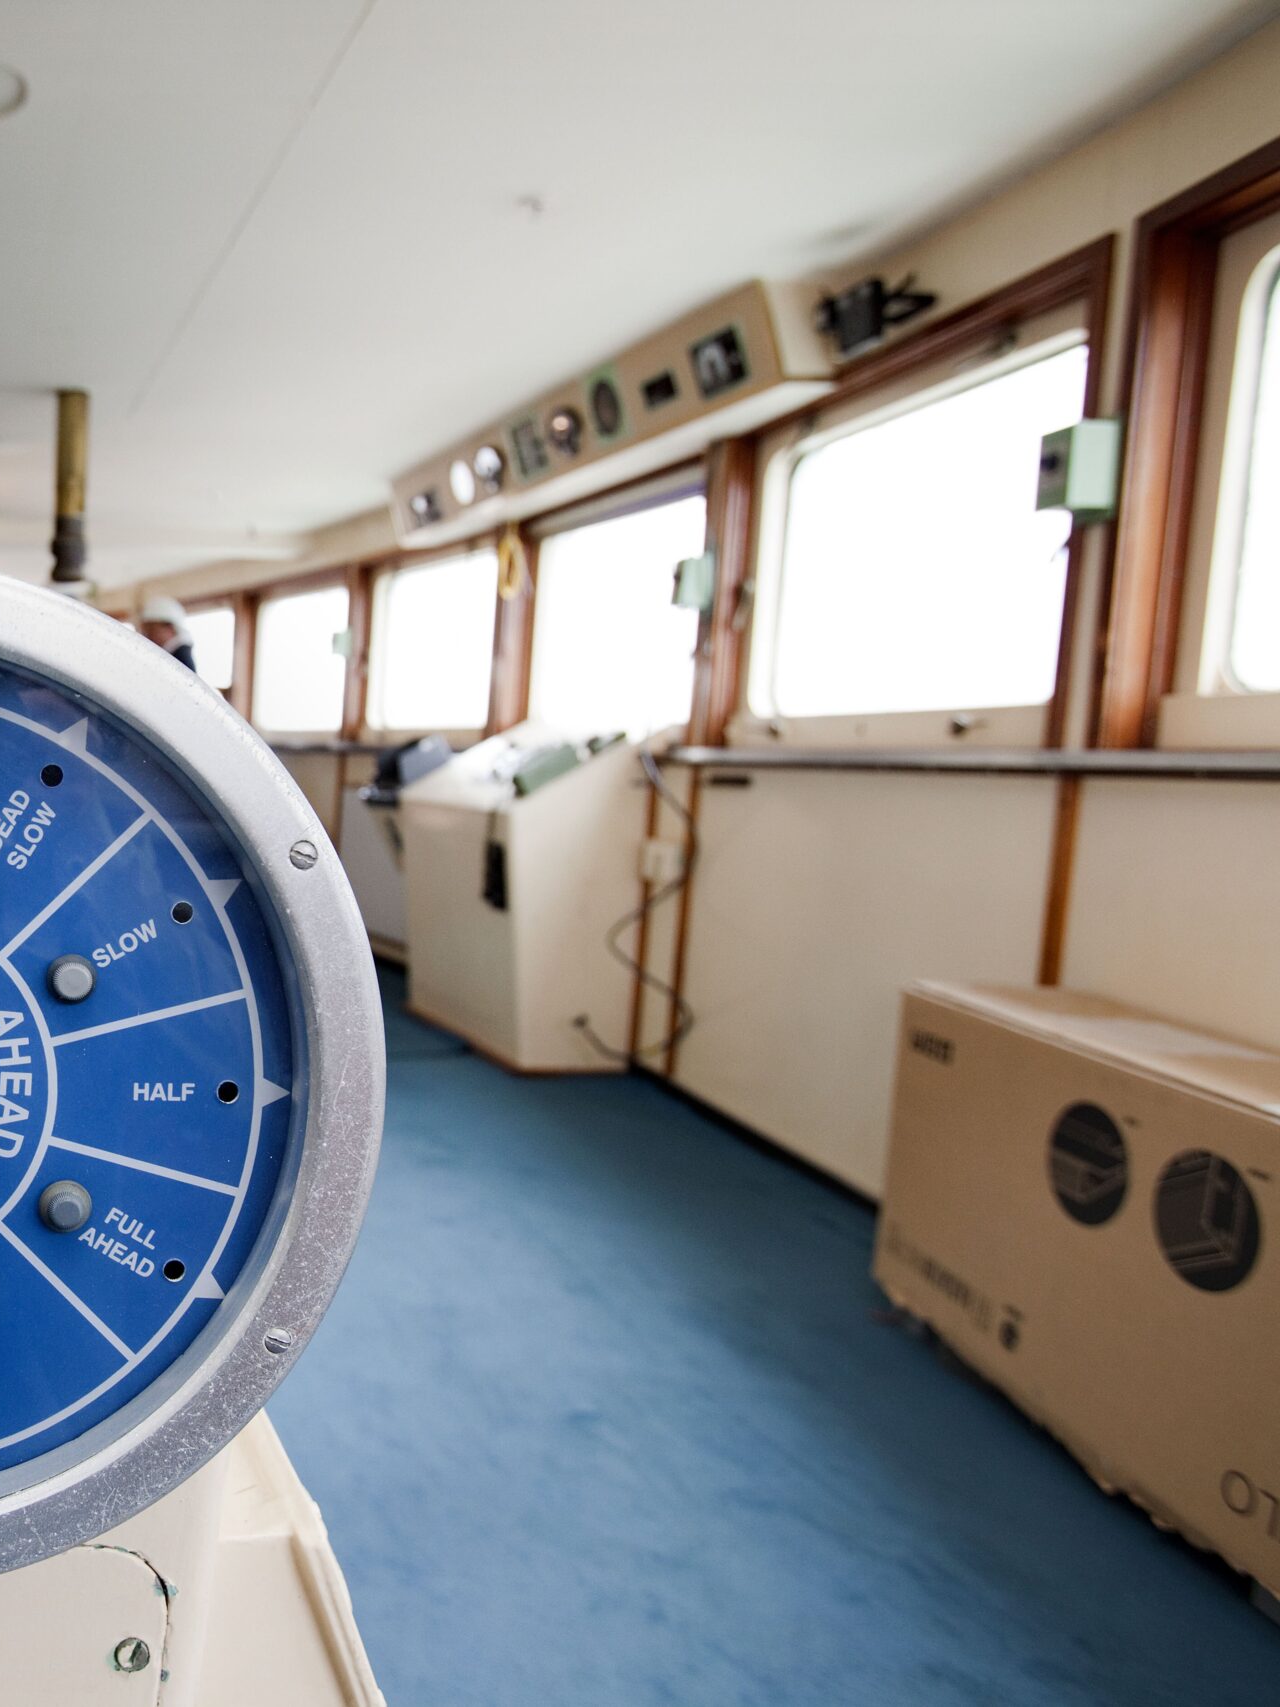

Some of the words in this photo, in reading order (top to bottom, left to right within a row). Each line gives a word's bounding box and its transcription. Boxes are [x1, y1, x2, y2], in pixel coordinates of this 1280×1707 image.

[6, 801, 57, 870] SLOW
[92, 919, 158, 969] SLOW
[132, 1082, 195, 1102] HALF
[78, 1227, 156, 1278] AHEAD
[104, 1207, 157, 1250] FULL
